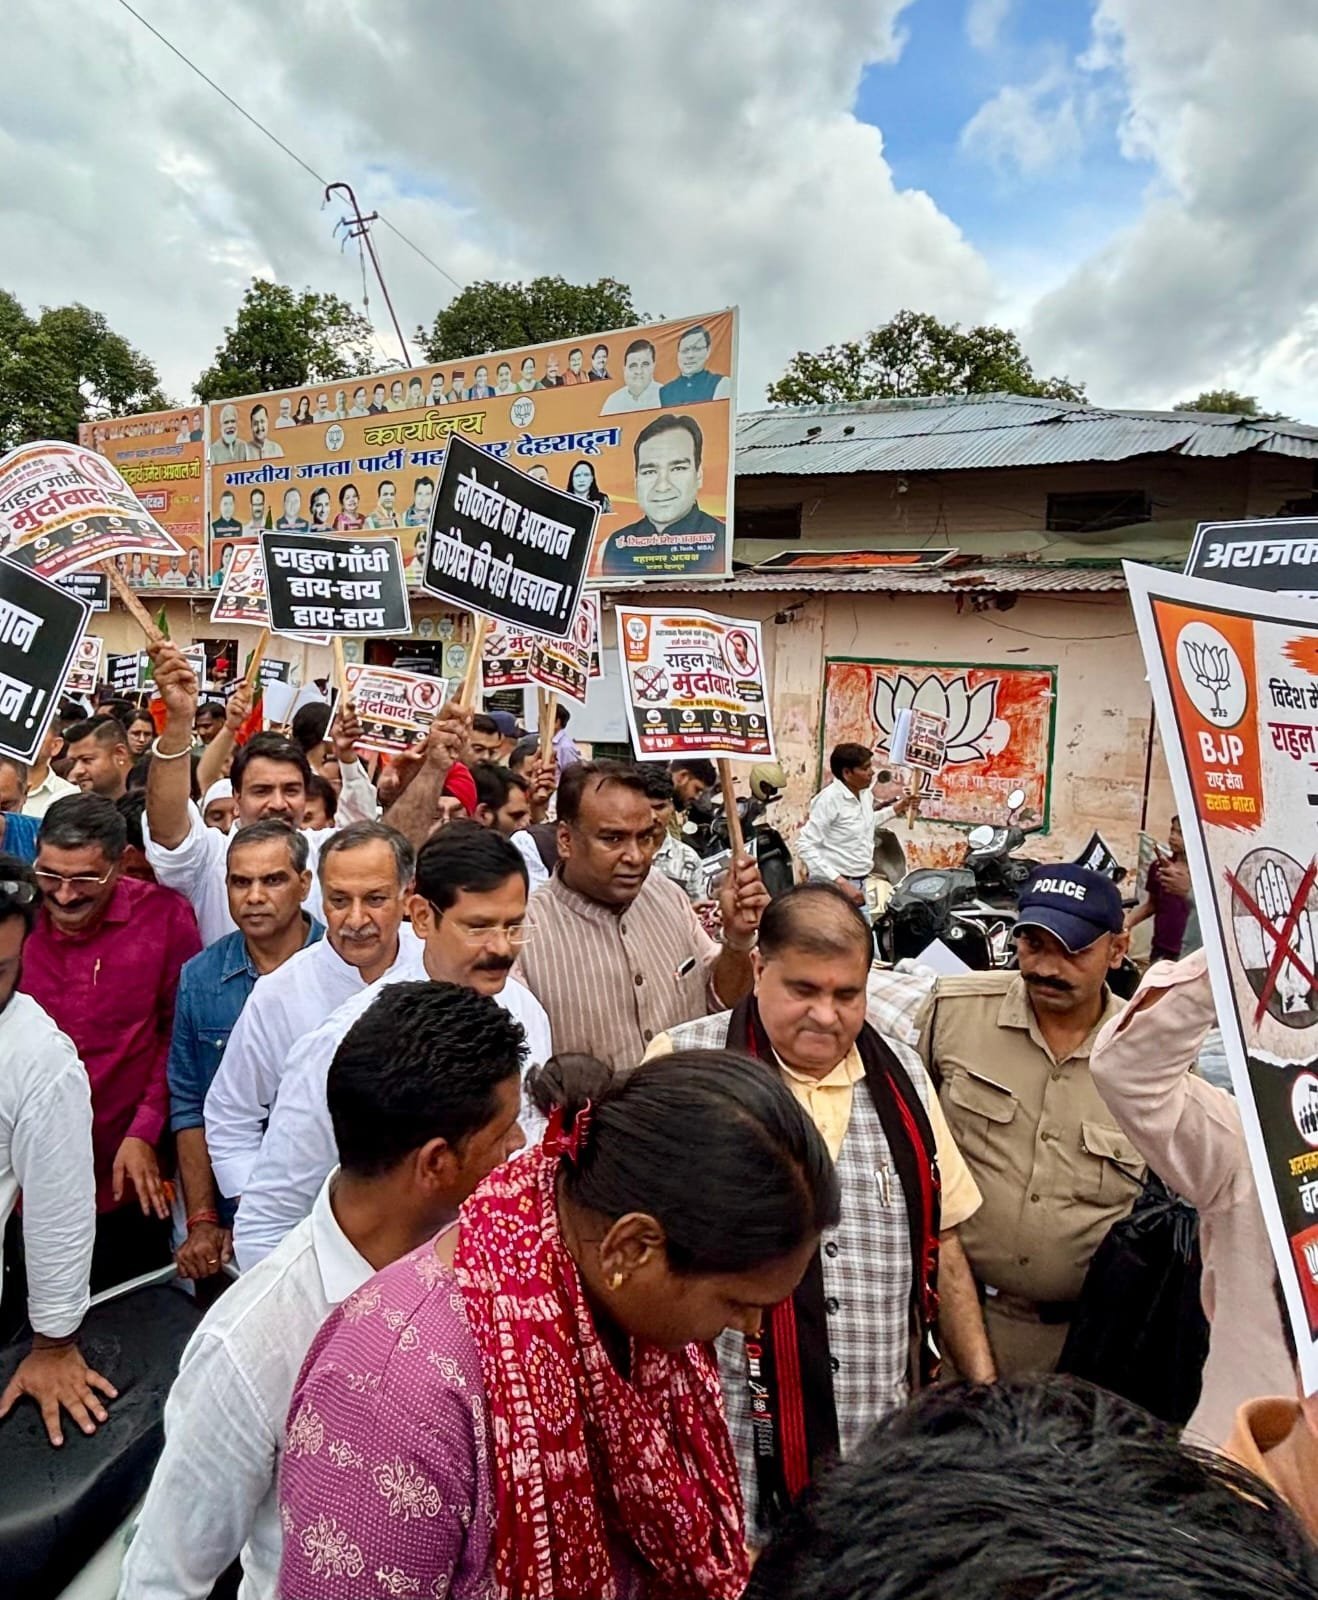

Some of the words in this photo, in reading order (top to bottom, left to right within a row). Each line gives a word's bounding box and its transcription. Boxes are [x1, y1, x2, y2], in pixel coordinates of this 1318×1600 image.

[364, 409, 486, 446] कार्यालय
[224, 464, 291, 486] भारतीय
[296, 459, 351, 479] जनता
[358, 448, 404, 472] पार्टी
[516, 426, 620, 456] देहरादून
[453, 466, 506, 531] लोकतंत्र
[500, 499, 522, 539] का
[516, 508, 576, 560] अपमान
[271, 547, 335, 574] राहुल
[337, 544, 390, 572] गाँधी
[431, 526, 474, 583] कांग्रेस
[470, 540, 494, 590] की
[488, 552, 515, 600] यही
[286, 577, 382, 600] हाय-हाय
[290, 605, 386, 628] हाय-हाय
[663, 653, 704, 672] राहुल
[670, 667, 737, 699] मुर्दाबाद!
[1268, 677, 1307, 710] विदेश
[1198, 731, 1245, 766] BJP
[1267, 722, 1316, 761] राहुल
[1231, 795, 1257, 813] भारत
[1032, 878, 1087, 901] POLICE
